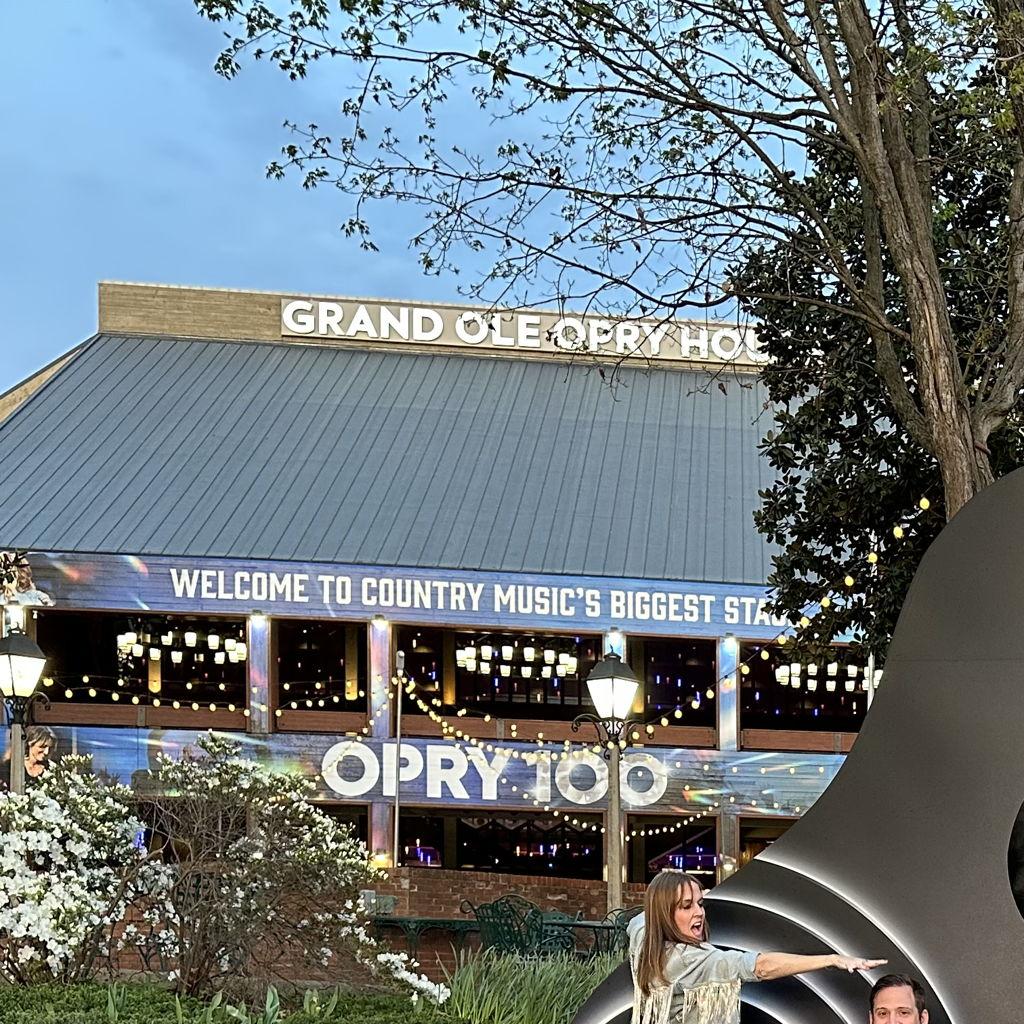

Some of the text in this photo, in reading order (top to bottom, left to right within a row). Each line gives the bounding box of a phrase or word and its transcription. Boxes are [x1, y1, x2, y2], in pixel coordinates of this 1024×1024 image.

[282, 300, 776, 364] GRAND OLE OPRY HOU
[169, 568, 797, 627] WELCOME TO COUNTRY MUSIC'S BIGGEST STAG
[321, 741, 668, 806] OPRY 100
